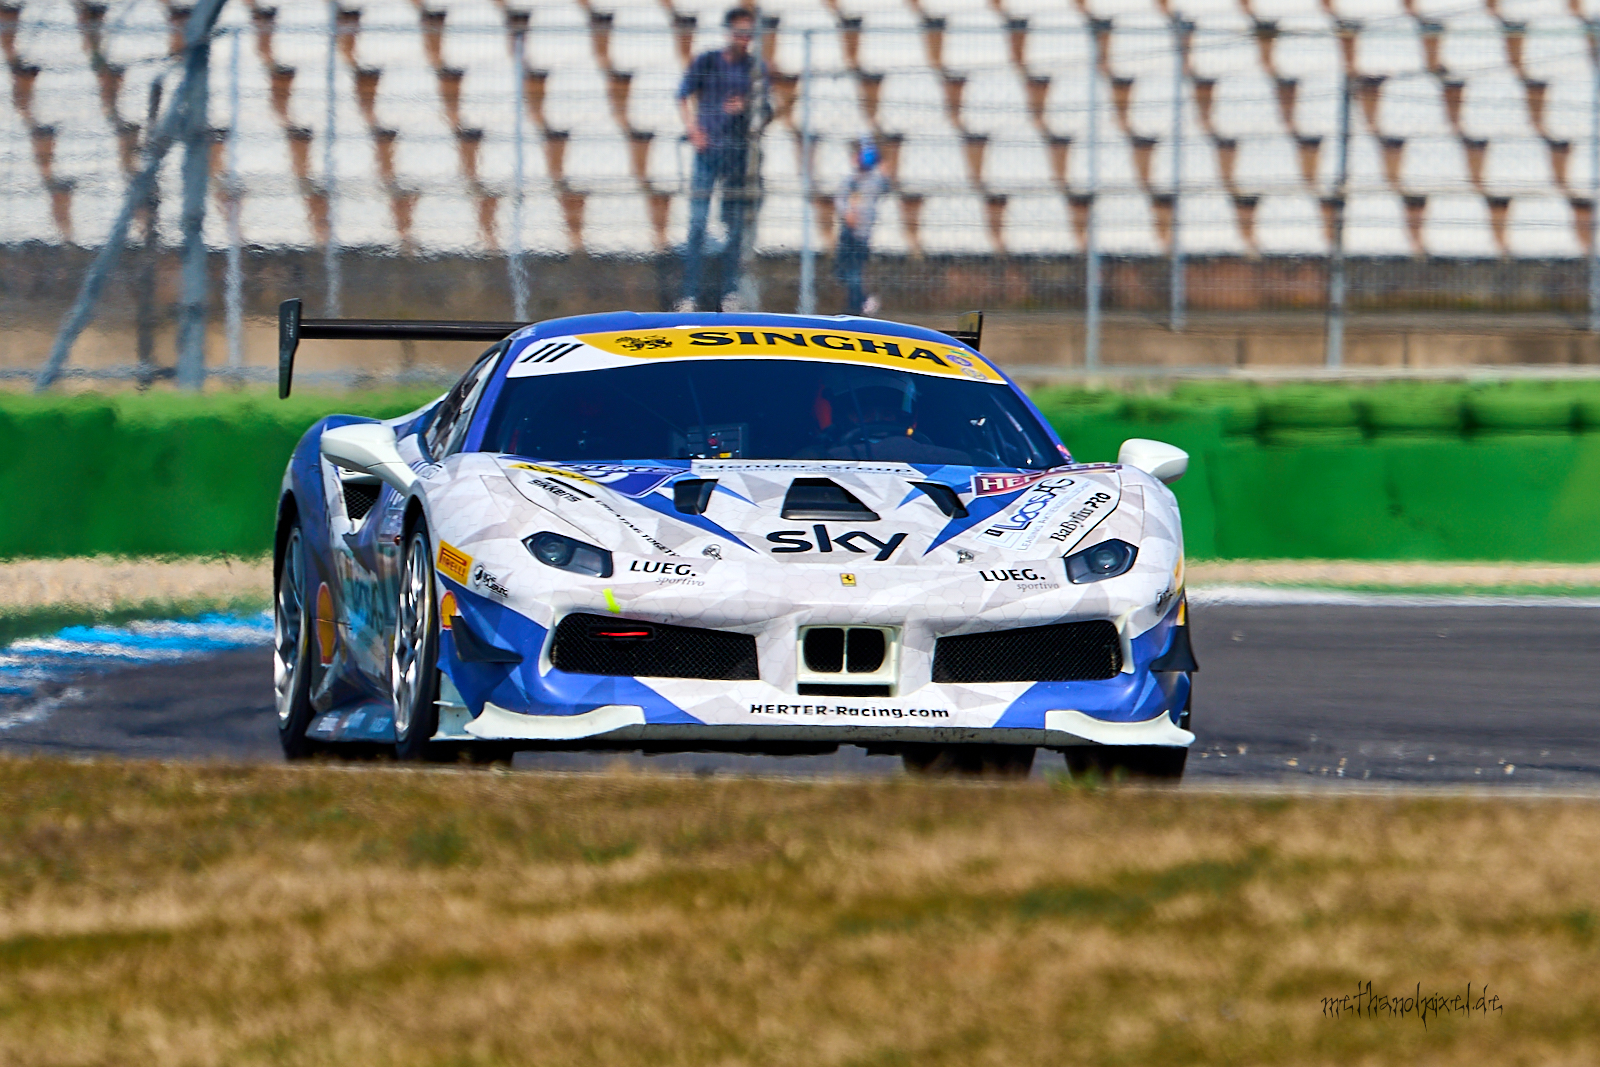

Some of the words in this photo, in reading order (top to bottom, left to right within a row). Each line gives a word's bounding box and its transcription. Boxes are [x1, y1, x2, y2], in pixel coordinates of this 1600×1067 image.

[688, 331, 951, 368] SINGHA
[766, 524, 909, 562] sky
[629, 560, 697, 577] LUEG.
[978, 568, 1046, 582] LUEG.
[750, 704, 950, 718] HERTER-Racing.com
